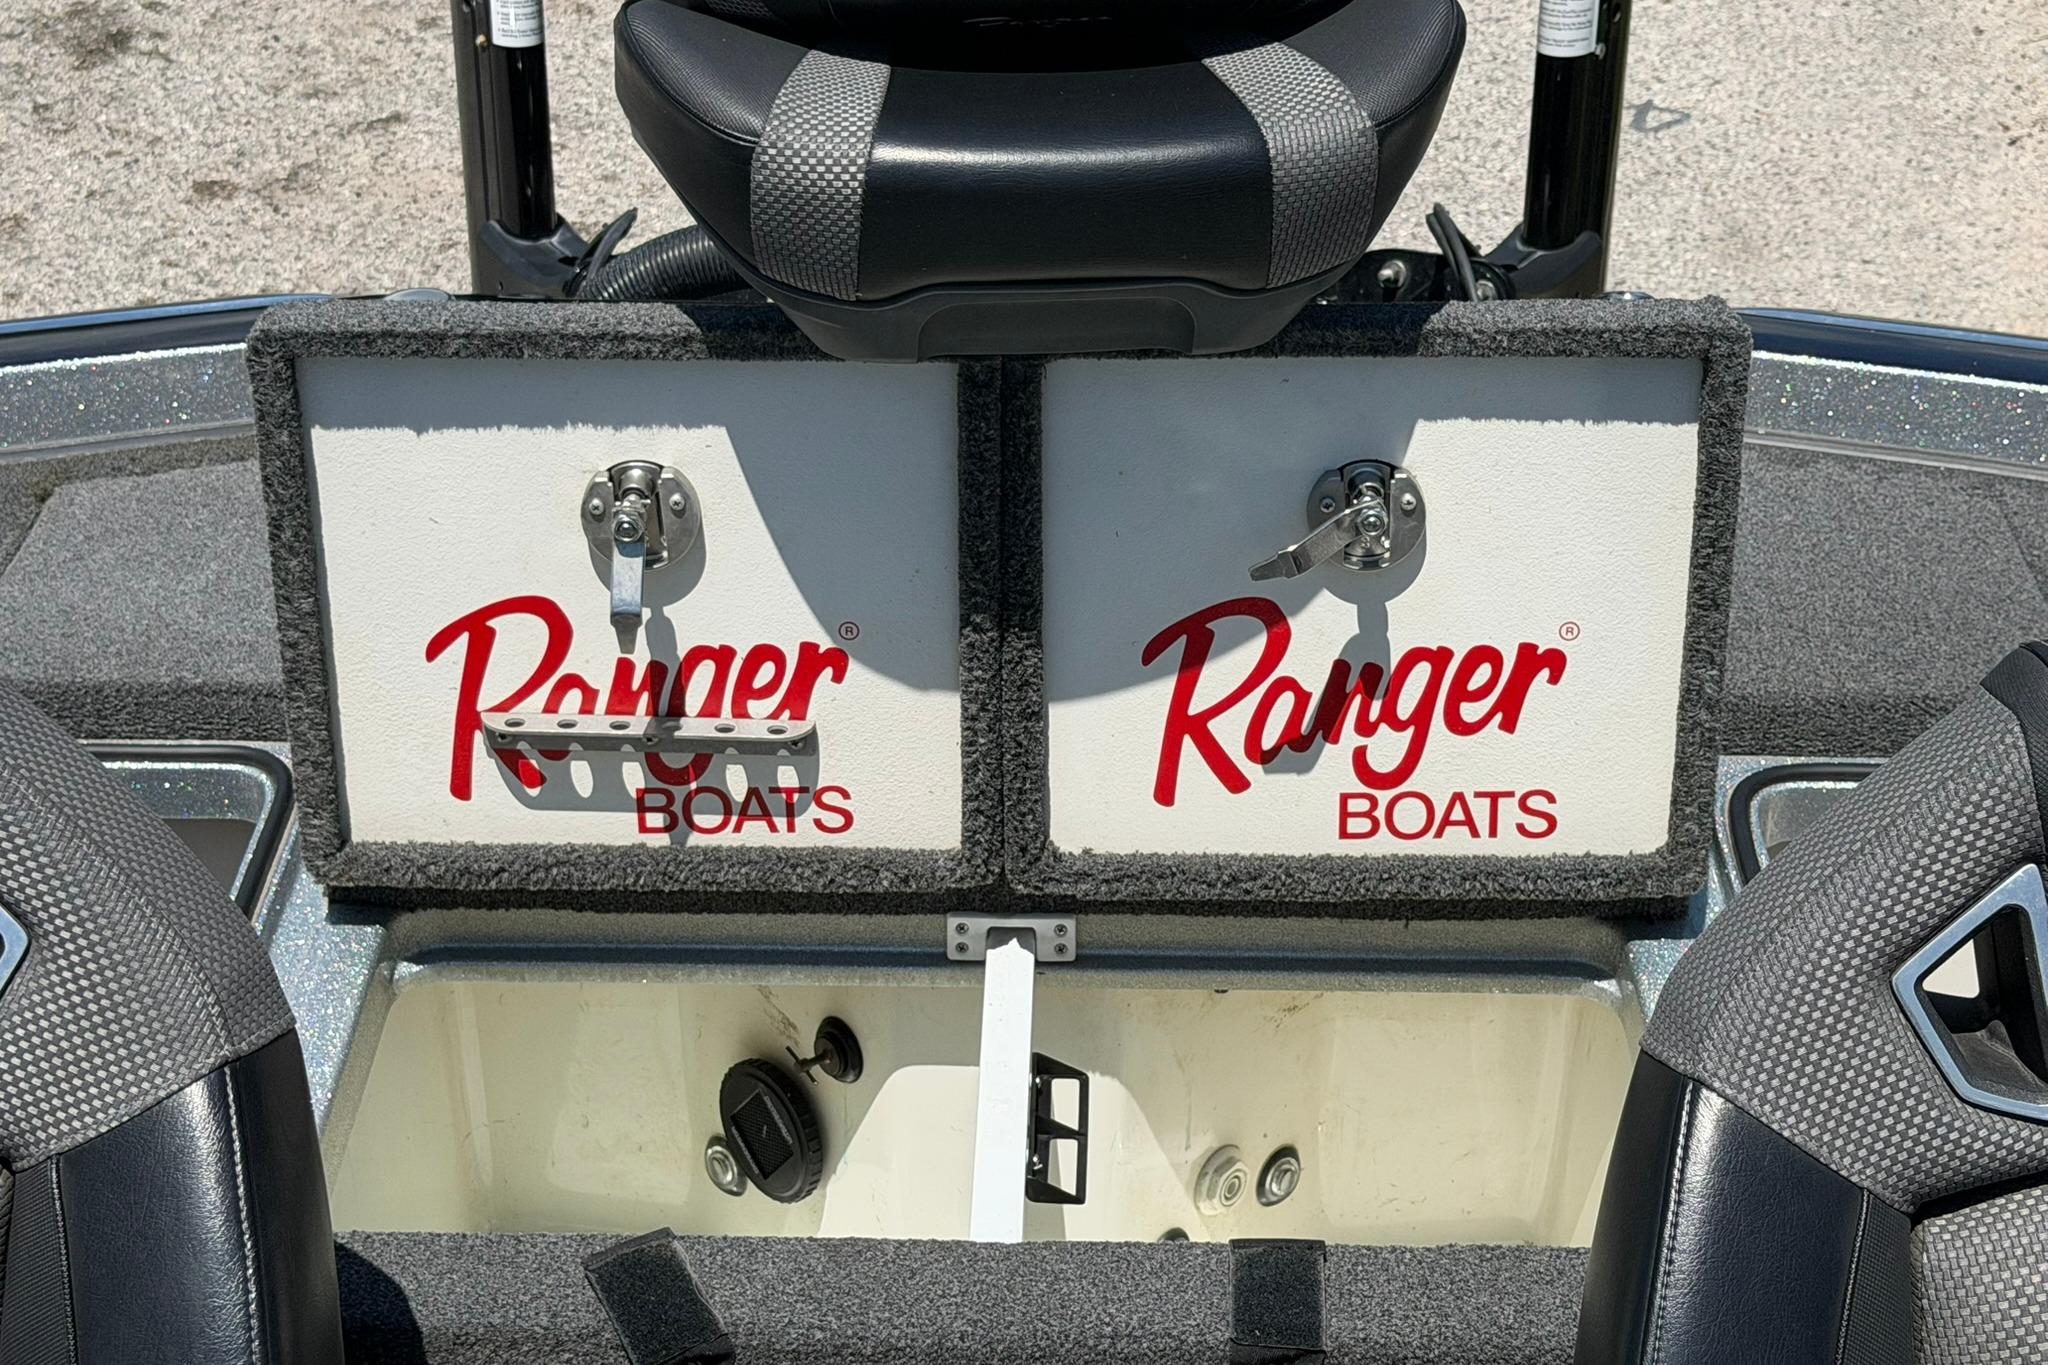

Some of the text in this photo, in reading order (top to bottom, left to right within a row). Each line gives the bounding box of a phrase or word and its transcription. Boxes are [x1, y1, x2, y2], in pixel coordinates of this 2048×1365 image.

[425, 595, 850, 801] Ranger
[1141, 596, 1568, 807] Ranger
[635, 785, 855, 834] BOATS
[1338, 789, 1558, 840] BOATS
